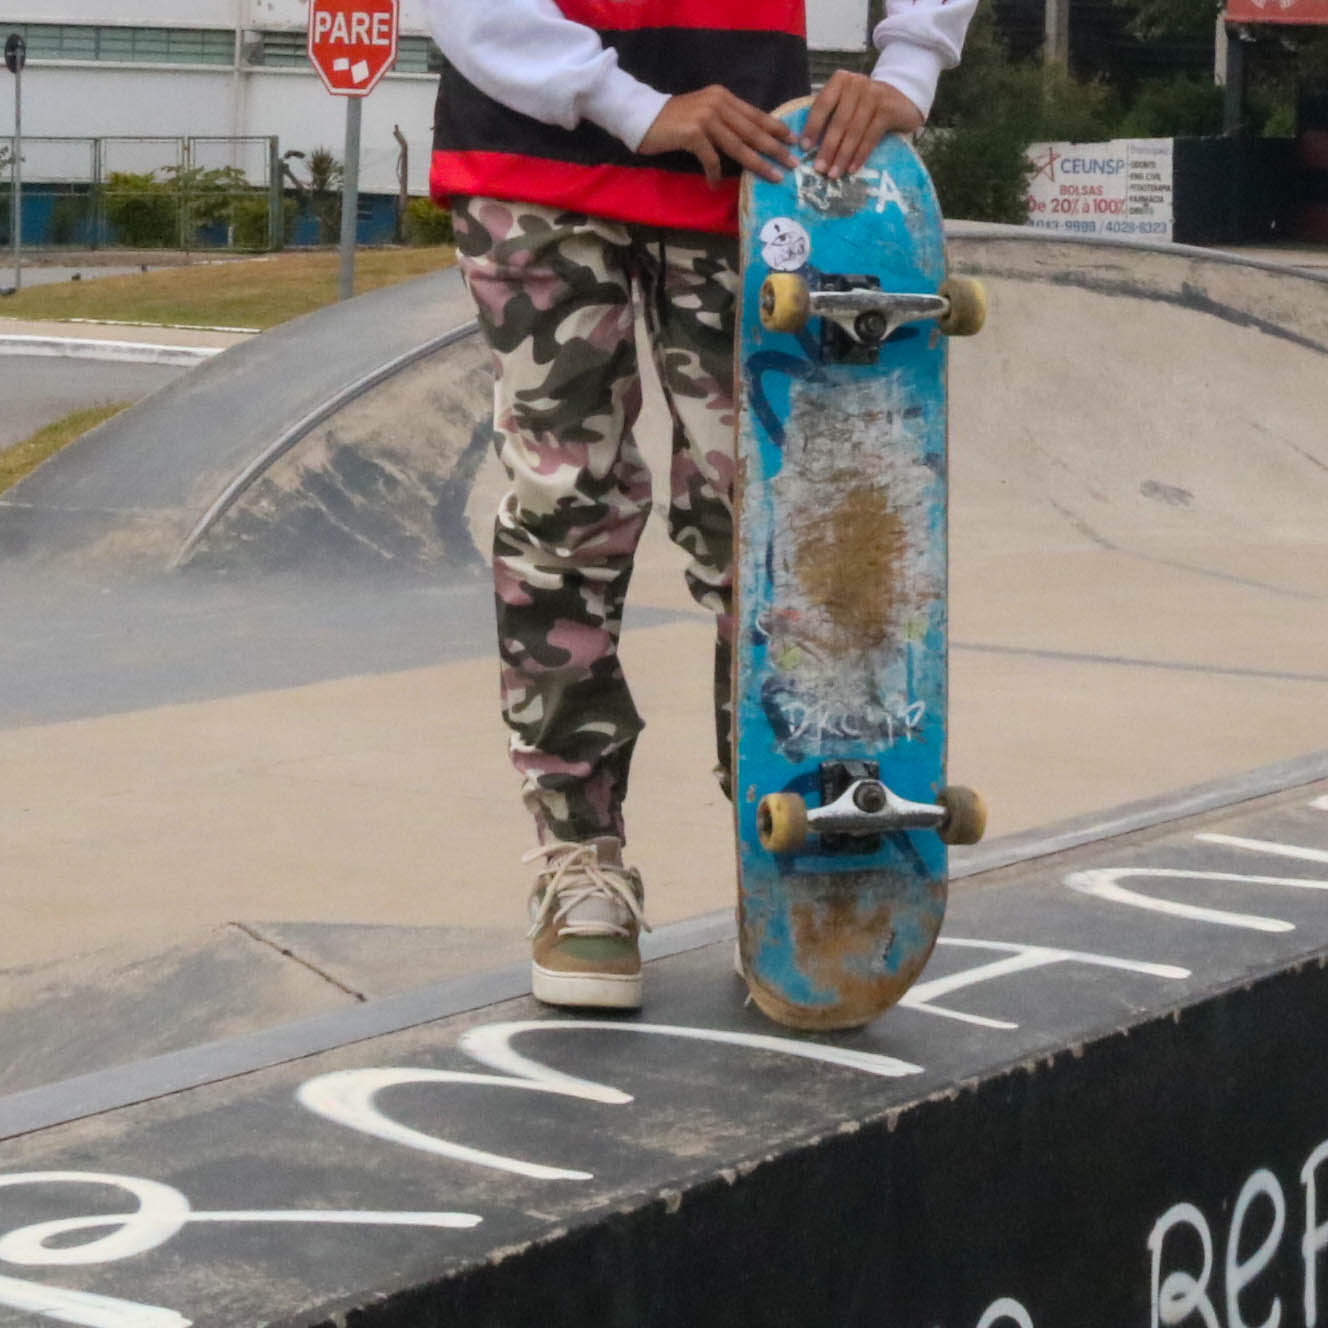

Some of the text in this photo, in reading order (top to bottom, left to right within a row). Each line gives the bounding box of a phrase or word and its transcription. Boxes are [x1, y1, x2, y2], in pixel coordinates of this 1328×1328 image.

[314, 11, 391, 46] PARE
[1060, 158, 1125, 175] CEUNSP
[1059, 184, 1105, 197] BOLSAS
